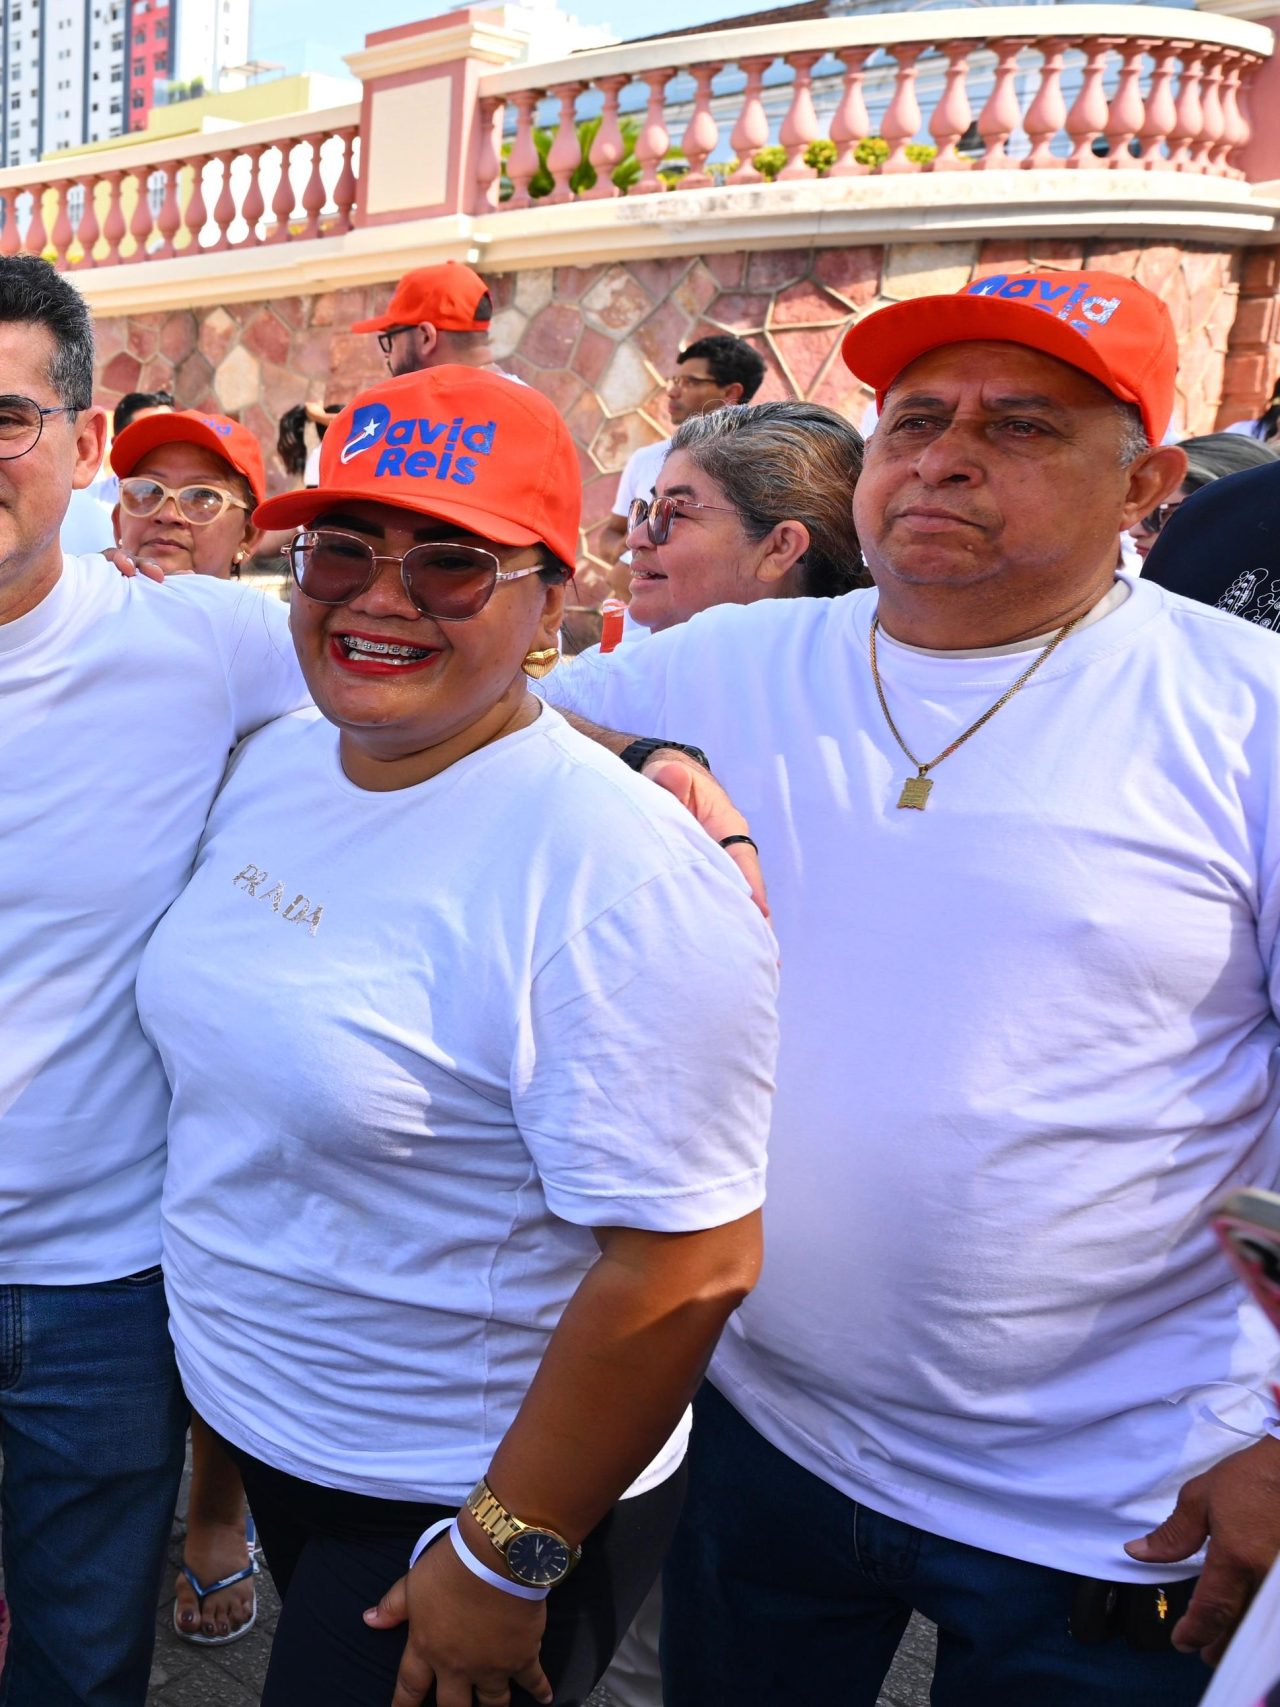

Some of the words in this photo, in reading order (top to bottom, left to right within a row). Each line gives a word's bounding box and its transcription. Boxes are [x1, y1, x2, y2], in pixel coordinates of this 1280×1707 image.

[341, 402, 497, 465] David
[374, 442, 479, 485] Reis
[232, 864, 324, 938] PRADA
